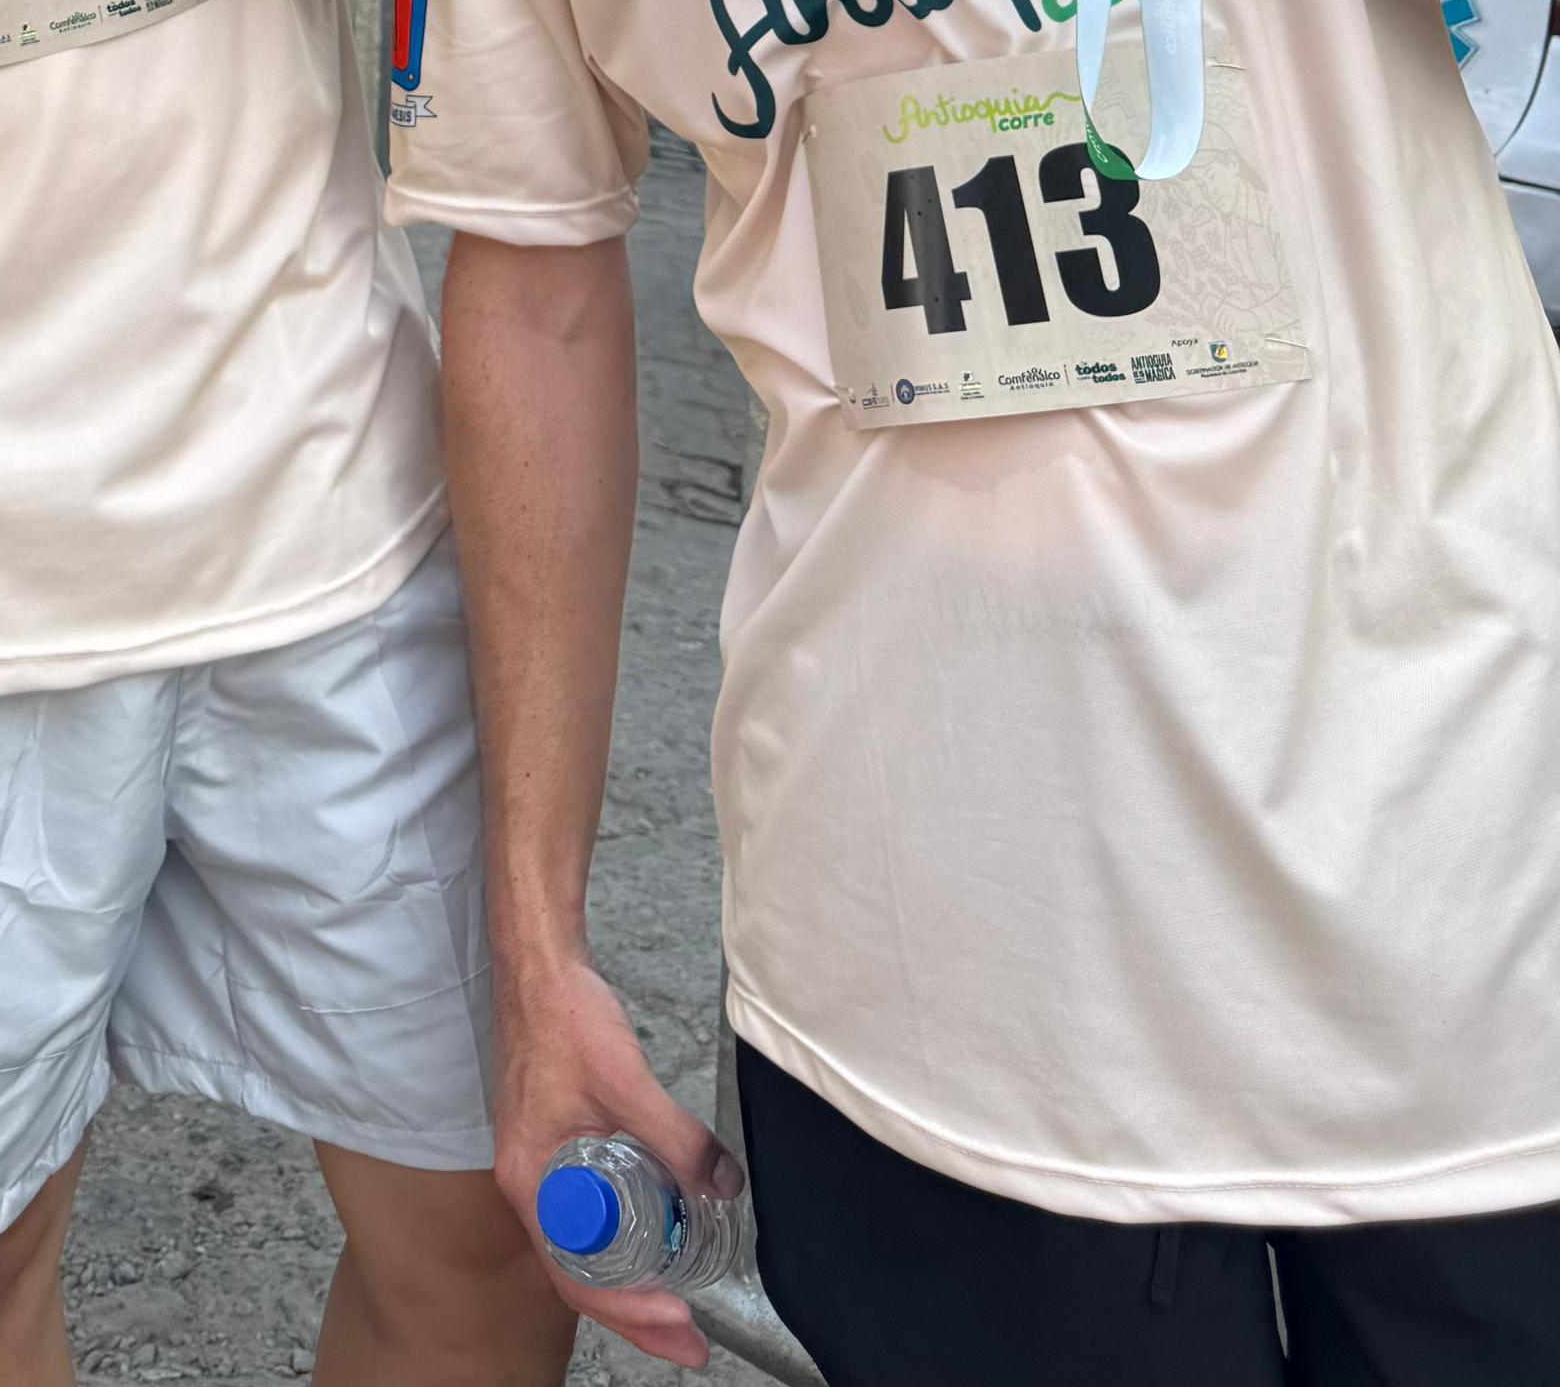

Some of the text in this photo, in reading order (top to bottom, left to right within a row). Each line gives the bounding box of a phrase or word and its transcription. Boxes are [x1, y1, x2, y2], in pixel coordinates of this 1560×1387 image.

[883, 88, 1082, 145] Antioquia
[997, 111, 1055, 133] corre
[880, 141, 1162, 336] 413
[997, 367, 1062, 386] Comfenalco
[1074, 361, 1118, 376] todos
[1092, 372, 1127, 384] todos
